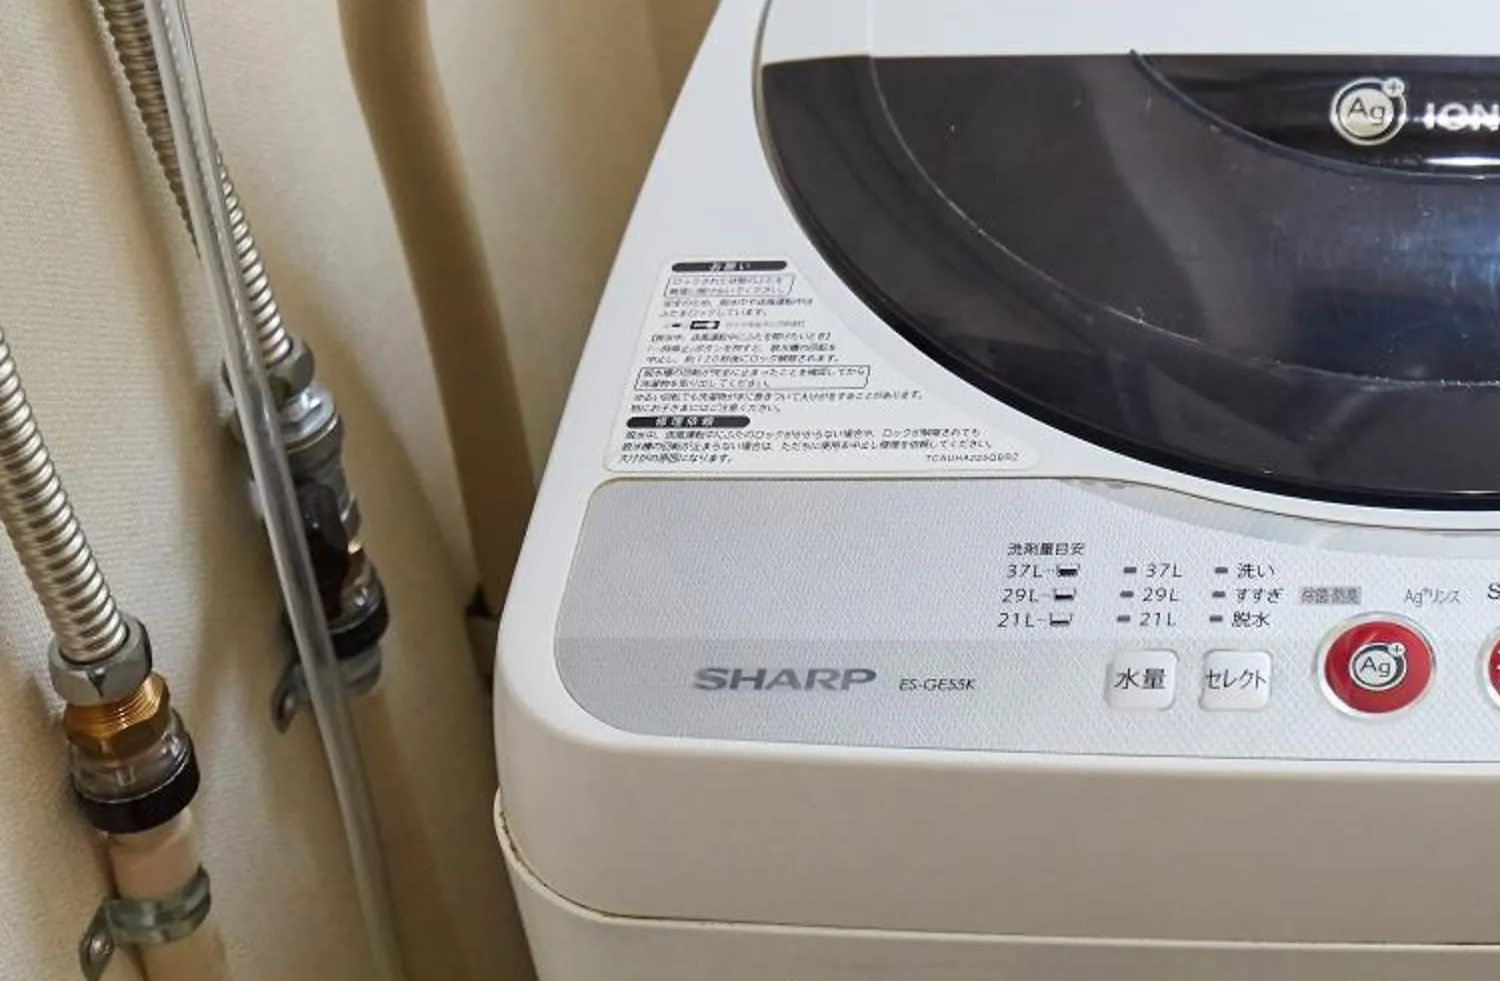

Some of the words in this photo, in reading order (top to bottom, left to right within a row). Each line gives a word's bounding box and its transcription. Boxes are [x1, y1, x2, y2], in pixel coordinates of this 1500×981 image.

[1423, 102, 1500, 132] ION
[1005, 563, 1043, 579] 37L
[1144, 562, 1184, 579] 37L
[1235, 562, 1276, 579] 洗い
[1001, 587, 1040, 604] 29L
[1140, 586, 1181, 603] 29L
[1233, 587, 1285, 604] すすぎ
[997, 612, 1036, 629] 21L
[1138, 611, 1178, 628] 21L
[1230, 612, 1271, 629] 脱水
[693, 666, 878, 691] SHARP
[1113, 668, 1167, 691] 水量
[1204, 668, 1268, 690] セレクト
